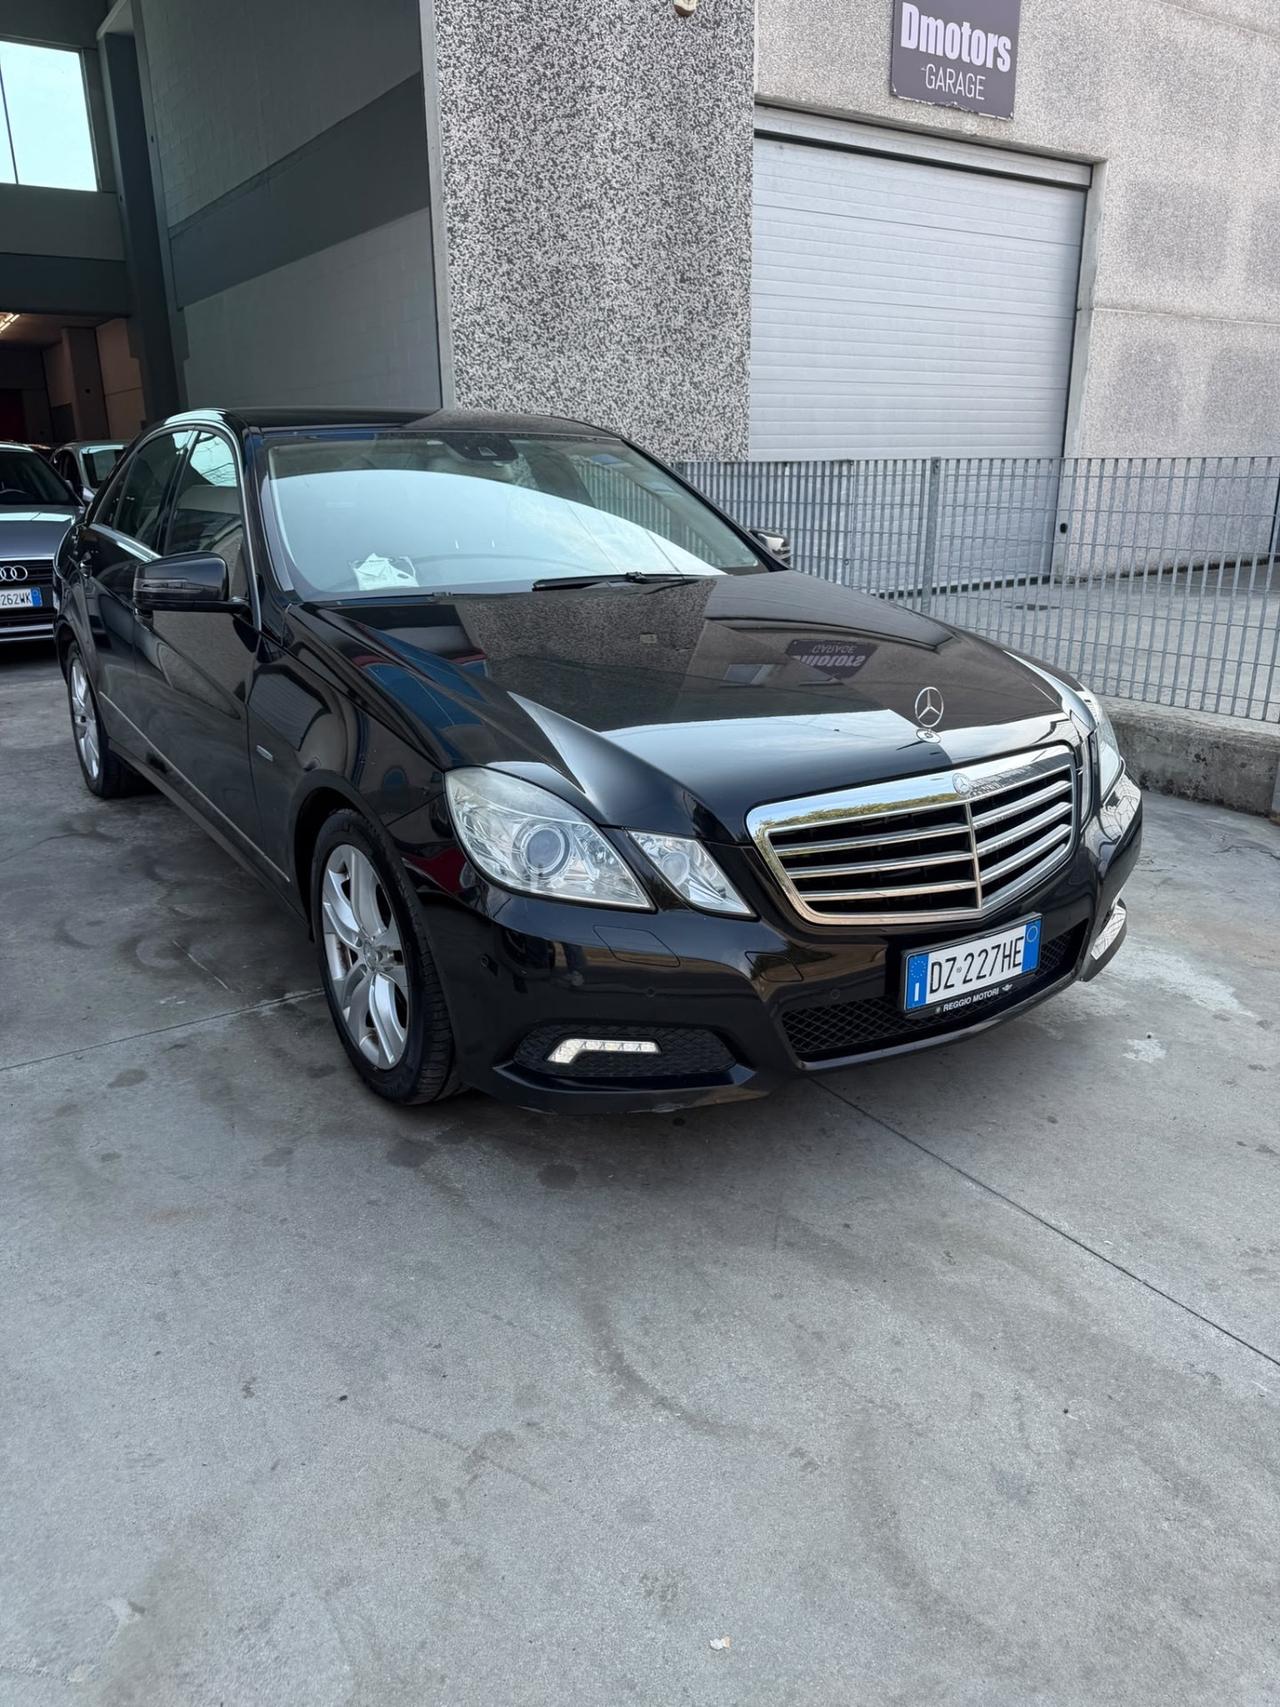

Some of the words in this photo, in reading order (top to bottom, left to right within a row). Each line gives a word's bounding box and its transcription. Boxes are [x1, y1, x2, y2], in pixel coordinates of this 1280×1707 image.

[901, 2, 1011, 72] Dmotors
[924, 63, 986, 100] GARAGE
[943, 997, 971, 1012] REGGIO
[972, 988, 999, 1002] MOTORI
